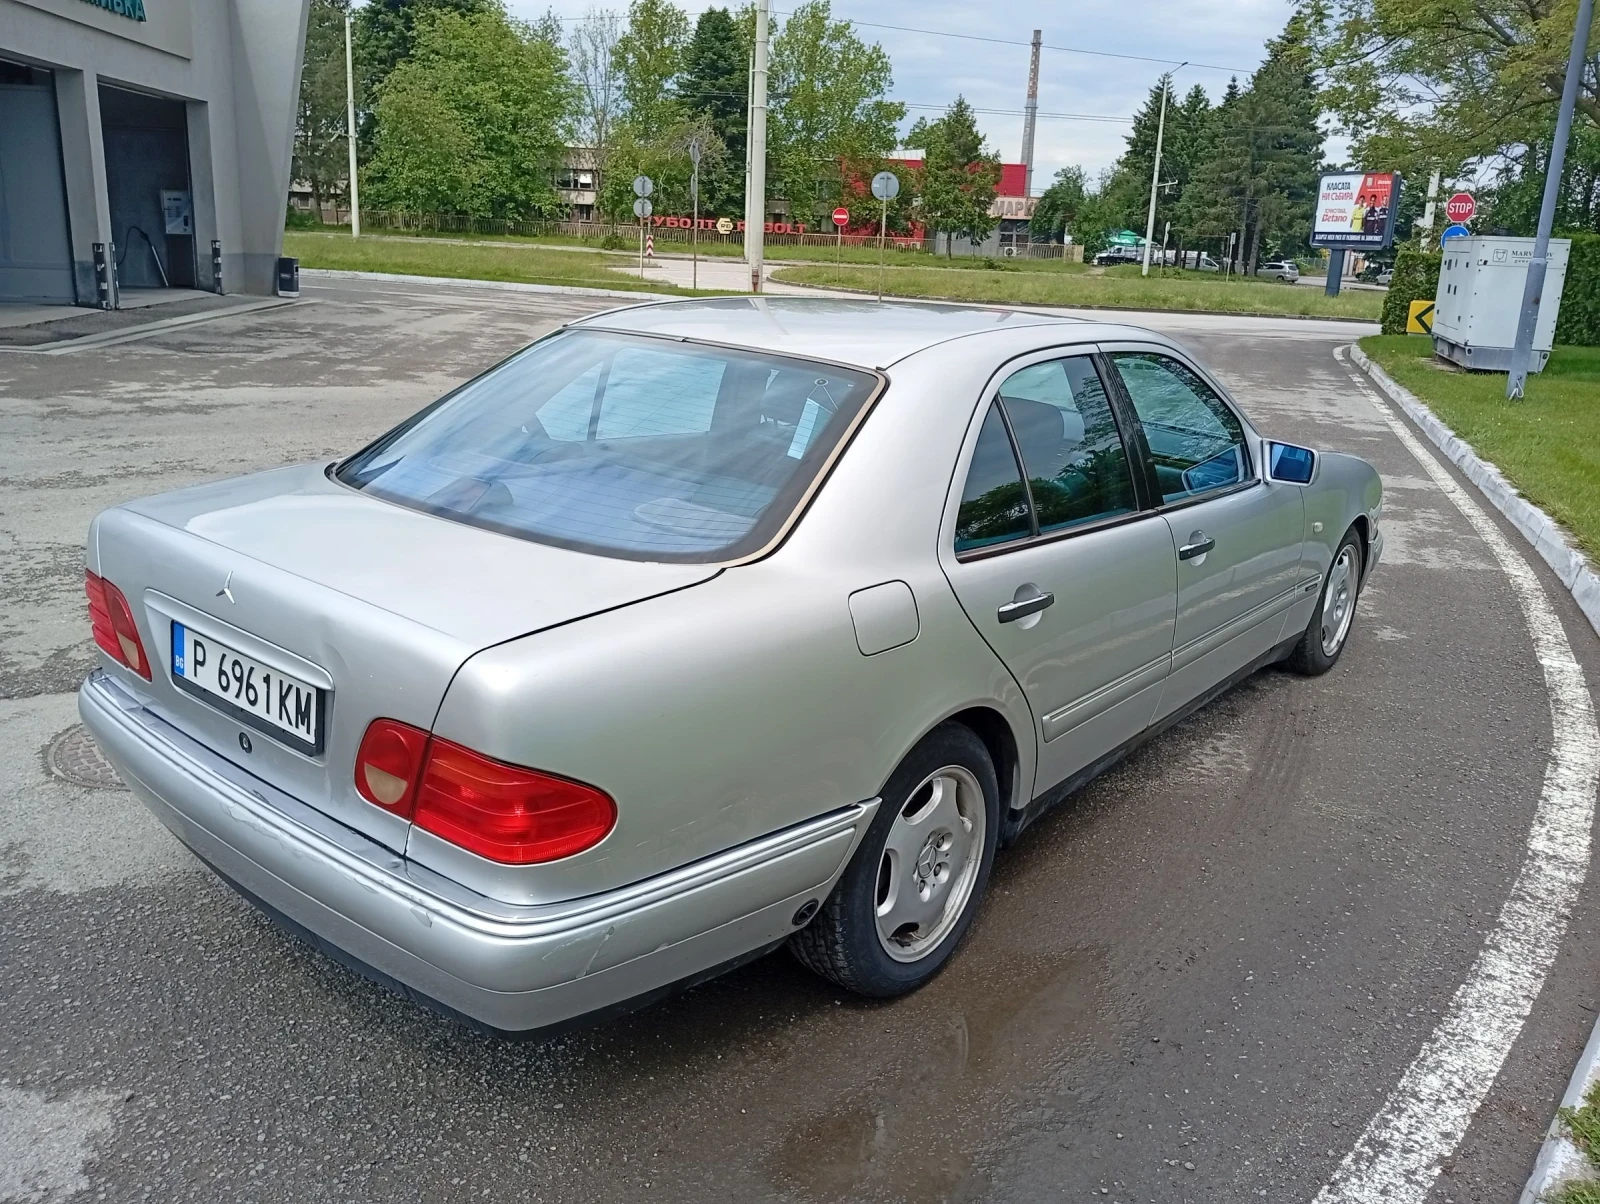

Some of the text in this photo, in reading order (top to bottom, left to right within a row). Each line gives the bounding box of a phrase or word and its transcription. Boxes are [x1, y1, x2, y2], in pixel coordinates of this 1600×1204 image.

[1326, 182, 1351, 191] КЛАСАТА
[1321, 192, 1354, 201] НИ СЪБИРА
[1448, 202, 1473, 214] STOP
[175, 654, 184, 670] BG
[193, 638, 206, 678] P
